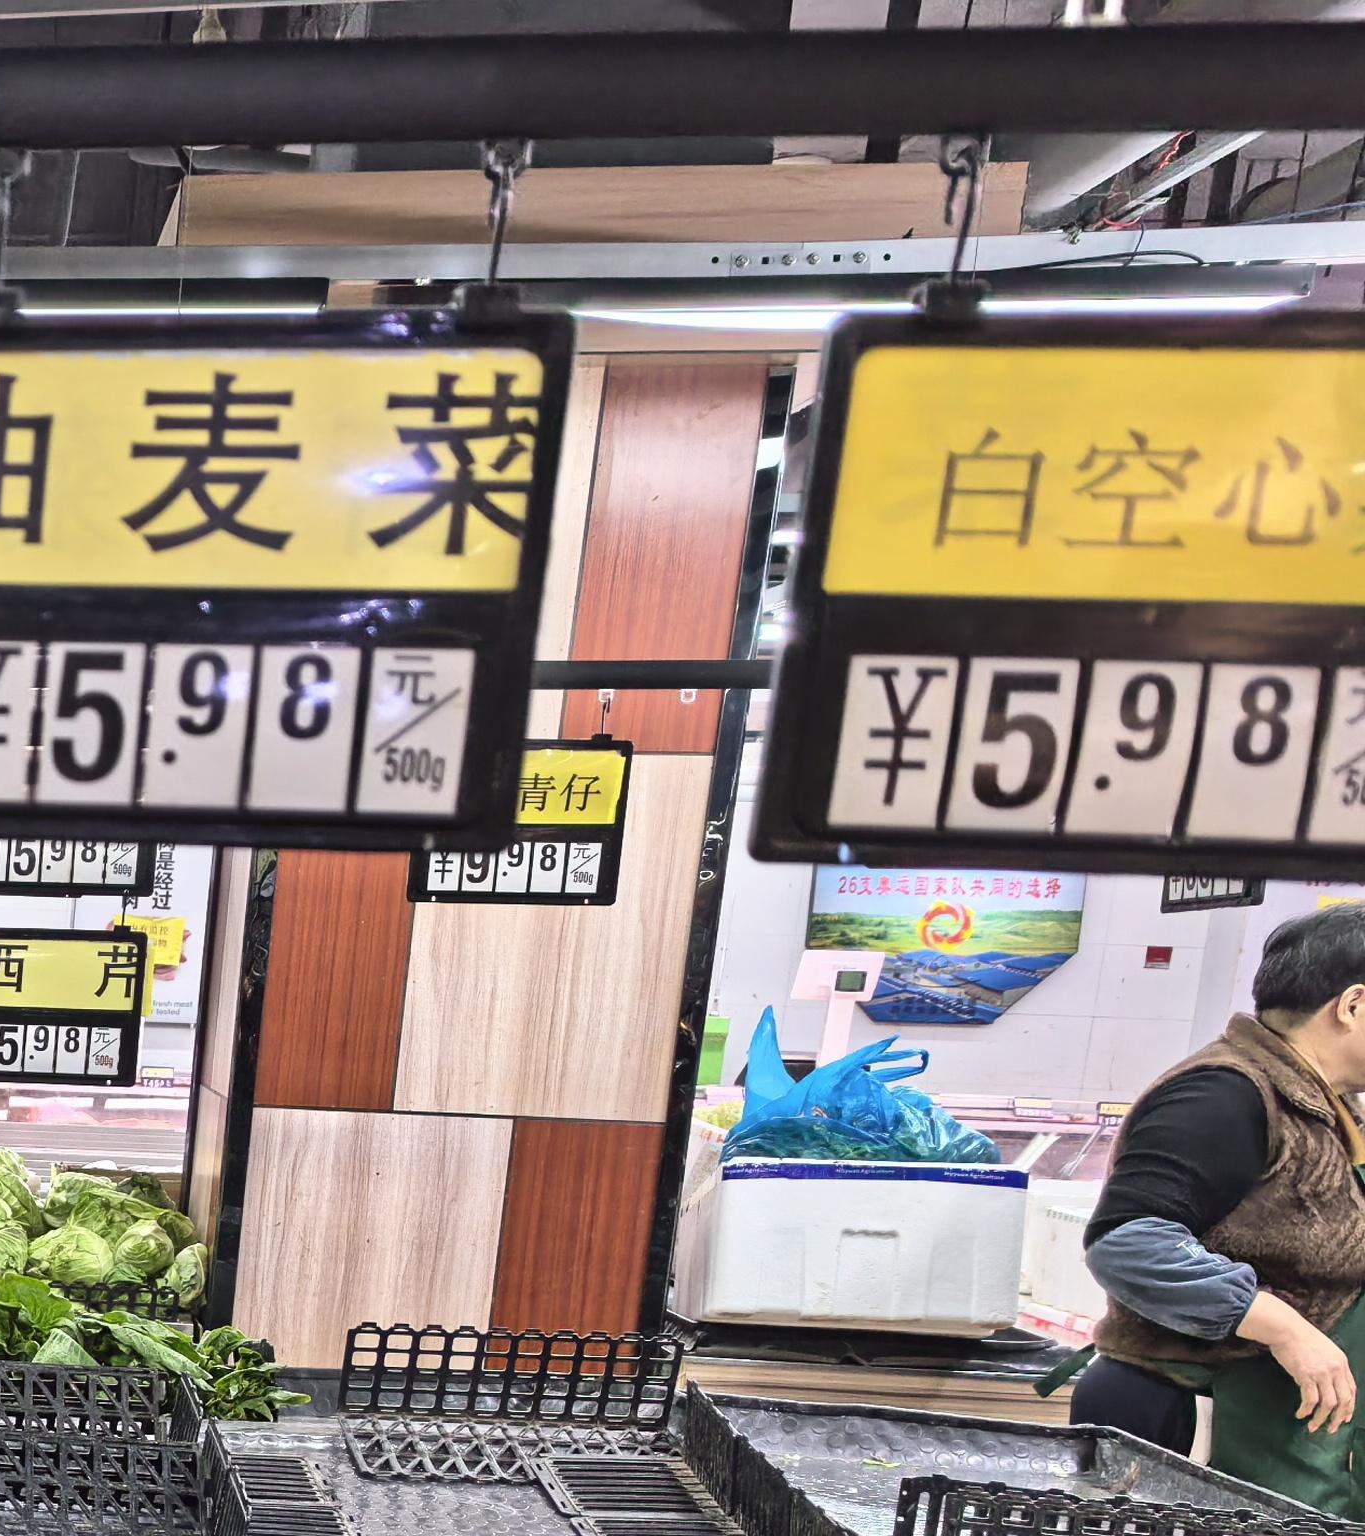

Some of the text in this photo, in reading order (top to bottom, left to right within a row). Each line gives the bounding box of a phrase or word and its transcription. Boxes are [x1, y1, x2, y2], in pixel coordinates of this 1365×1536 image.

[933, 428, 1365, 552] 白空心
[864, 667, 1292, 811] ¥5.98
